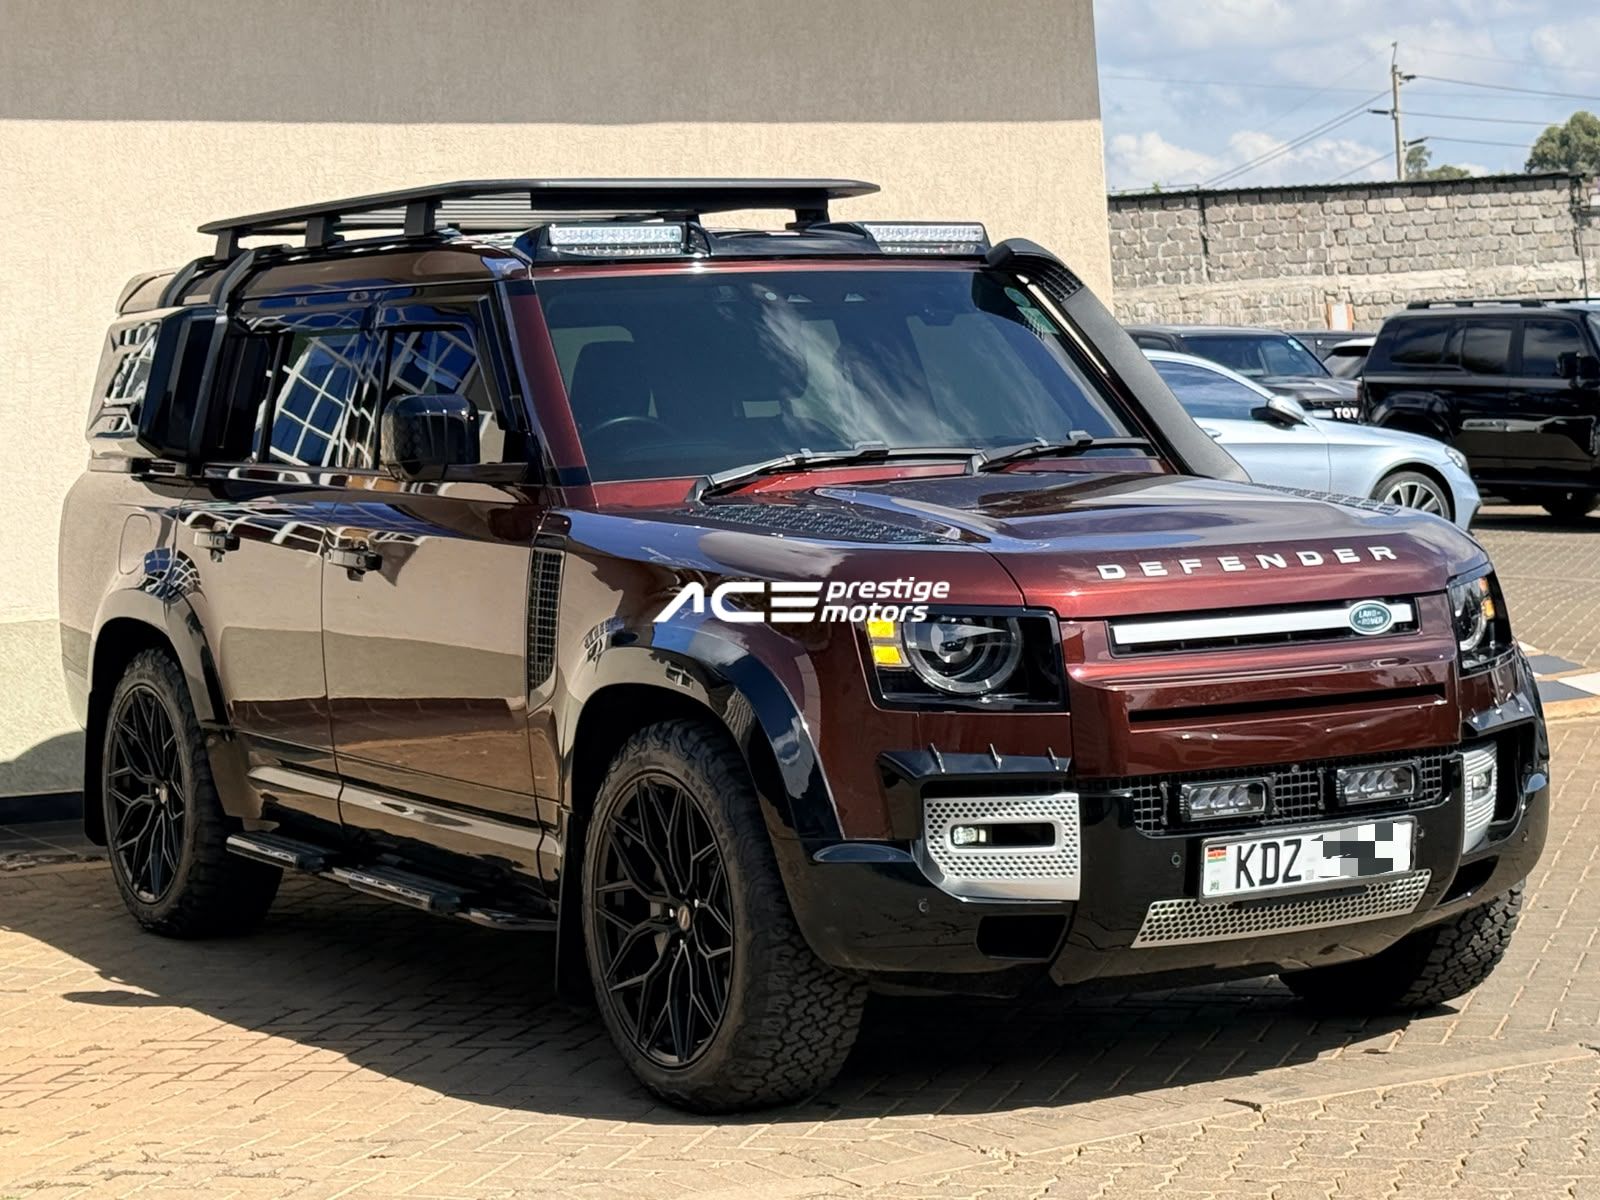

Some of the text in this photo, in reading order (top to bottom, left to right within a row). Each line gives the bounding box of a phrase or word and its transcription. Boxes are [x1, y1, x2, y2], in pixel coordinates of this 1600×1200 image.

[1334, 407, 1359, 419] TOY
[1096, 546, 1397, 580] DEFENDER
[1235, 838, 1302, 889] KDZ
